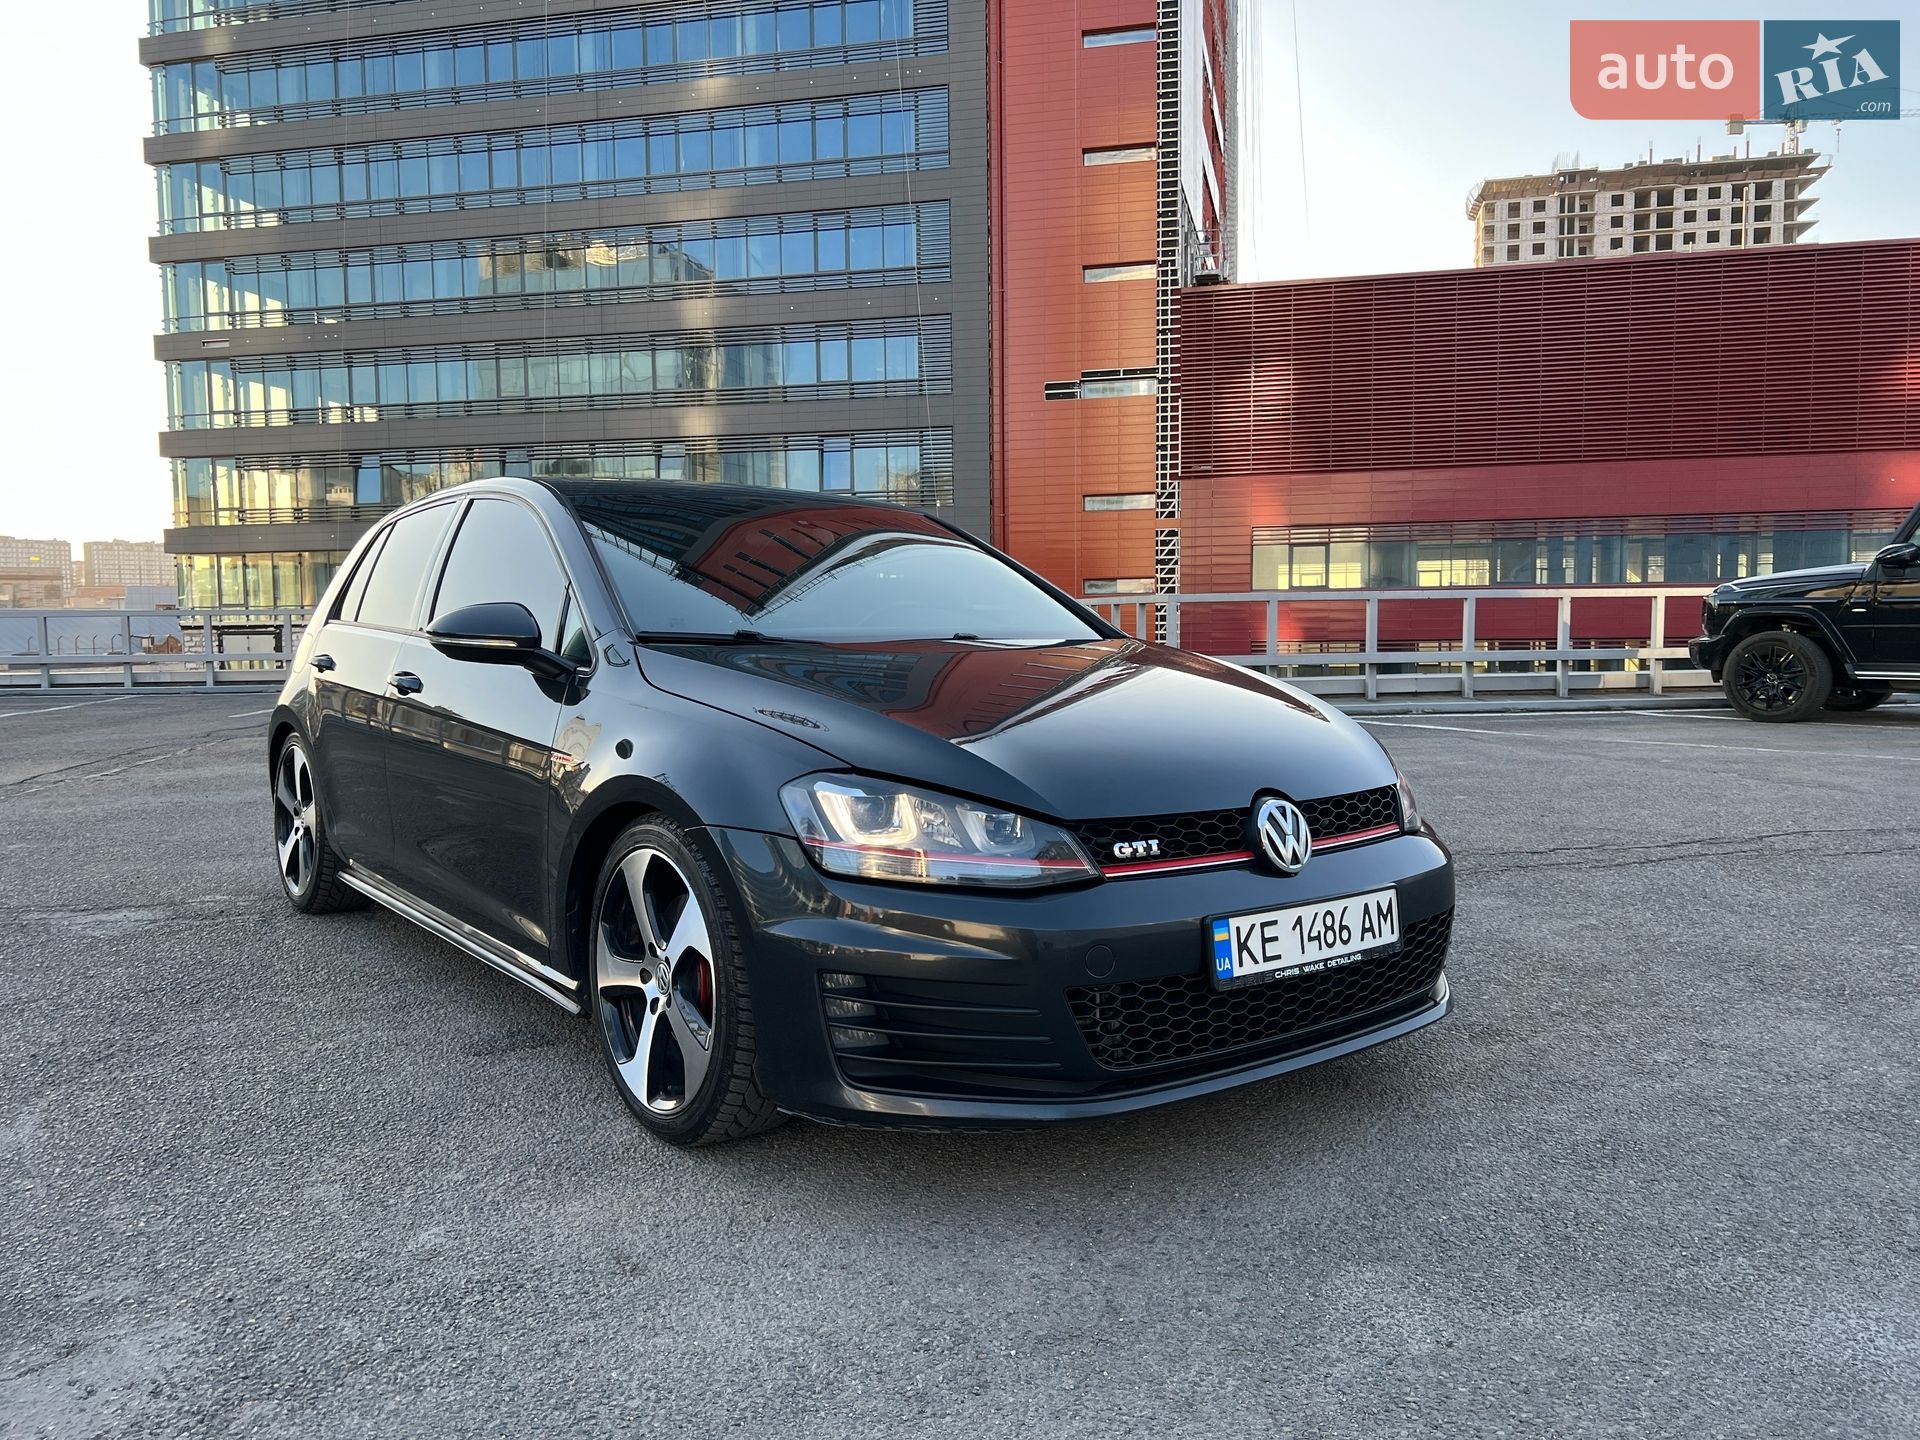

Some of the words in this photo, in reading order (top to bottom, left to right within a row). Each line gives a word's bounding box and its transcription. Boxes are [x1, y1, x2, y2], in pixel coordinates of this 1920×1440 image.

[1113, 839, 1161, 859] GTI
[1235, 919, 1282, 968] KE
[1291, 906, 1352, 955] 1486
[1360, 897, 1395, 942] AM
[1216, 958, 1232, 972] UA
[1274, 967, 1300, 979] CHRIS
[1302, 962, 1325, 973] WAKE
[1327, 953, 1362, 968] DETAILING
